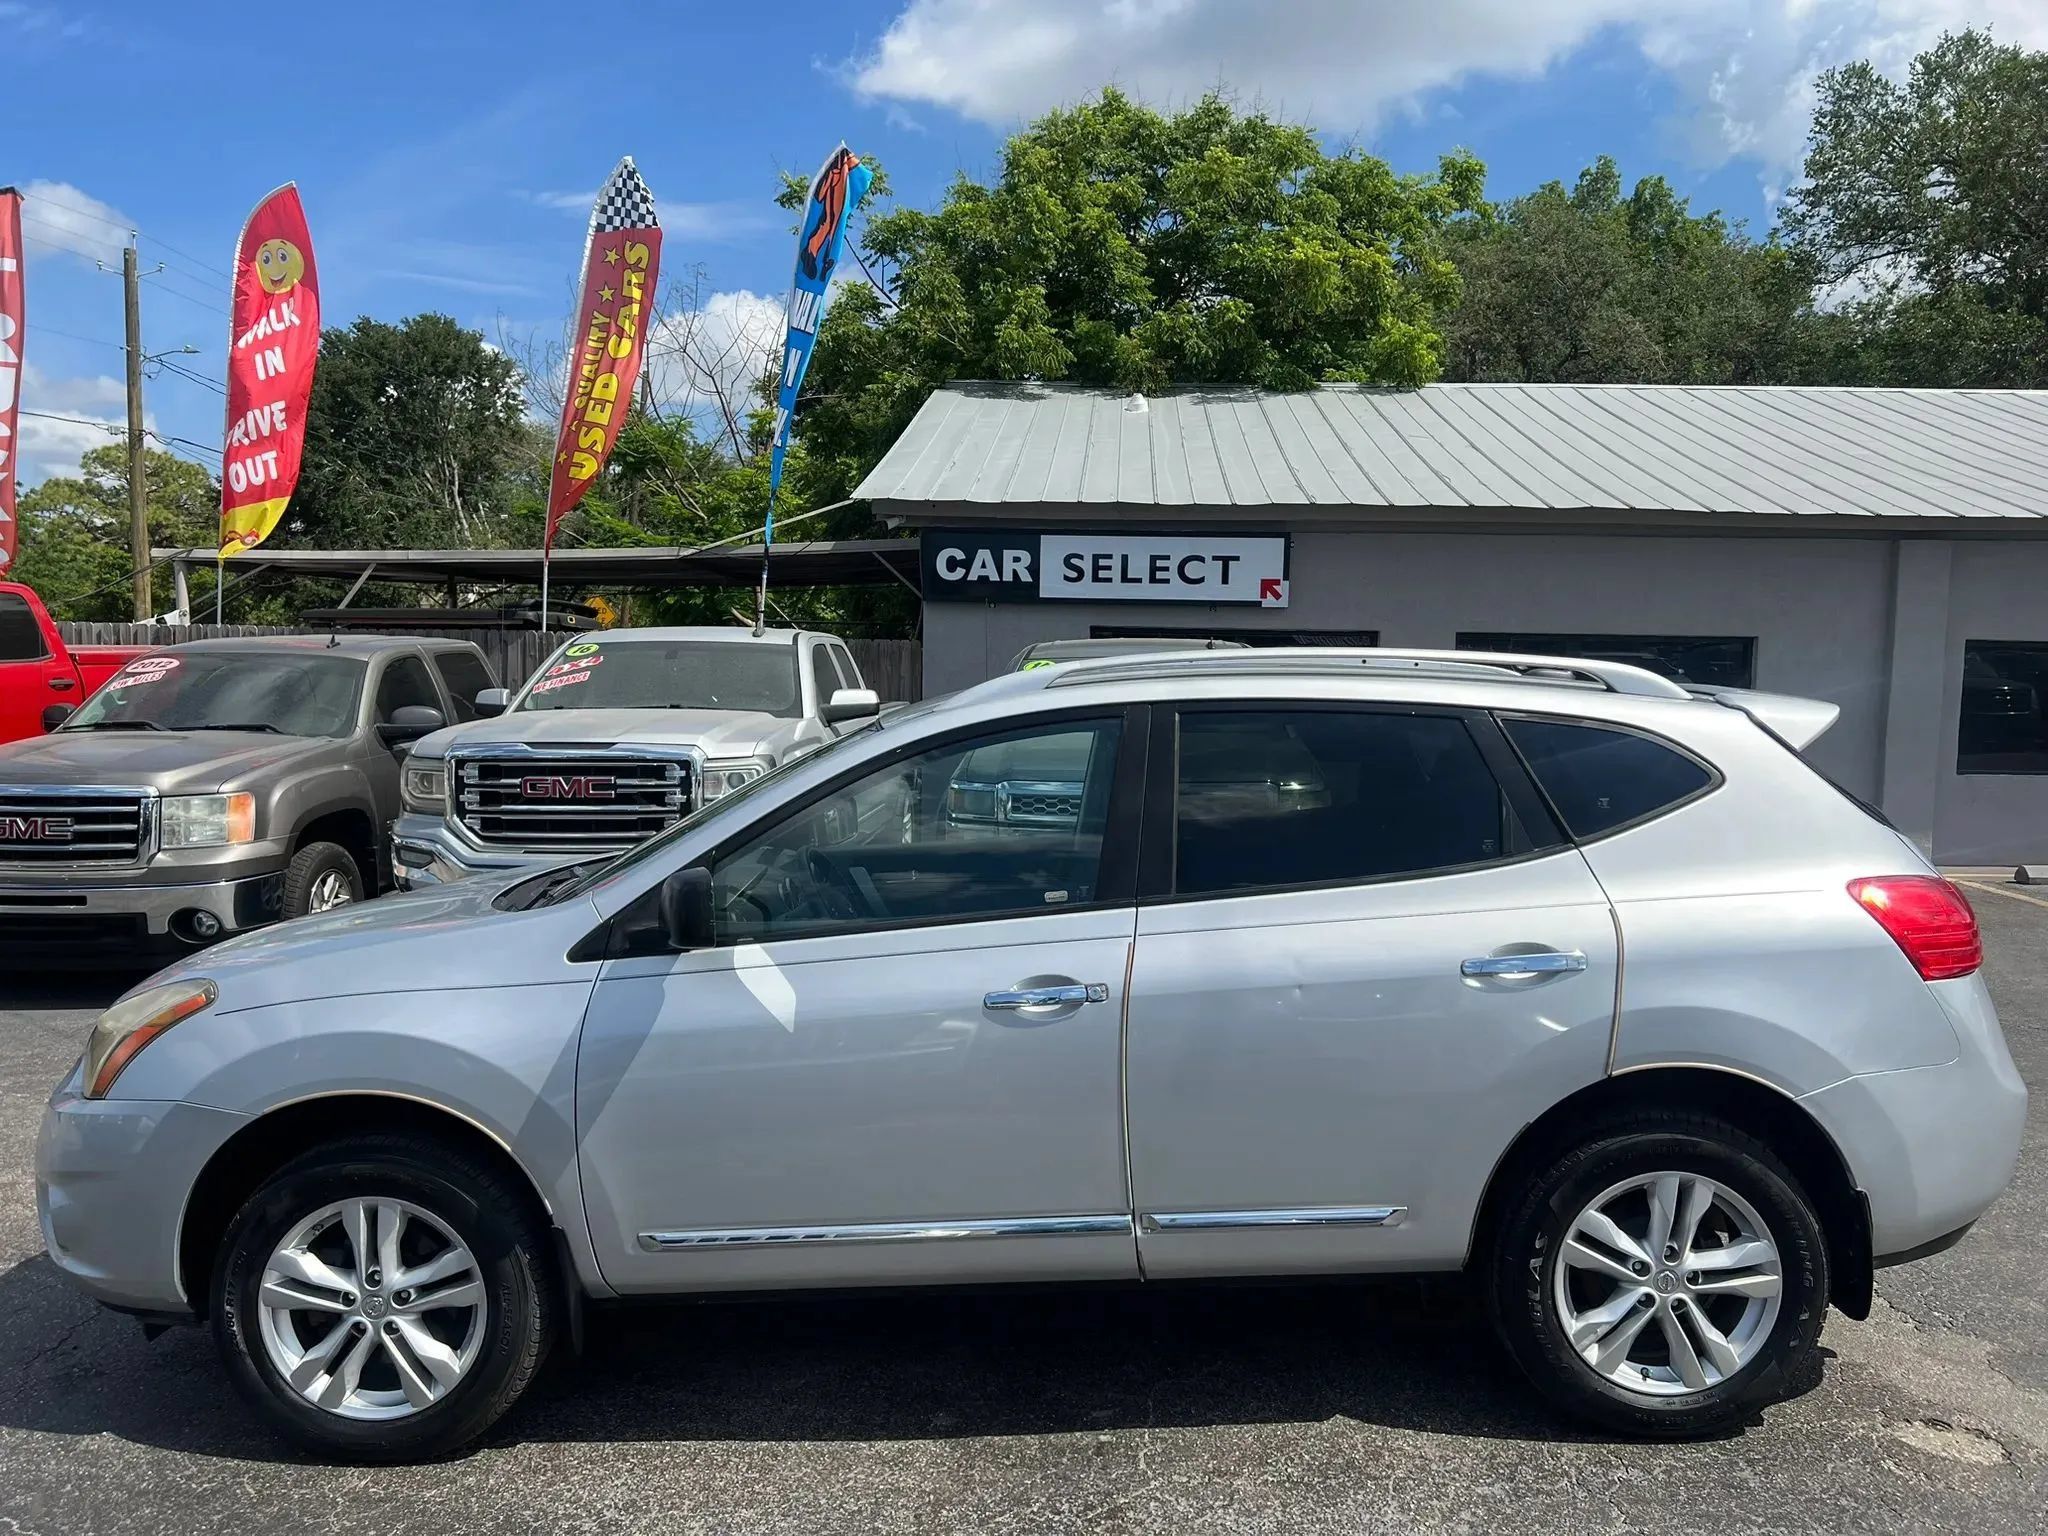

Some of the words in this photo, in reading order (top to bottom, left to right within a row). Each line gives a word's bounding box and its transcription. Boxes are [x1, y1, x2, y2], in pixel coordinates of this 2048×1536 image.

[237, 297, 301, 349] WALK
[254, 345, 287, 381] IN
[568, 372, 619, 480] USED
[607, 240, 650, 359] CARS
[574, 310, 611, 409] QUALITY
[224, 400, 288, 448] RIVE
[228, 450, 279, 493] OUT
[936, 547, 1034, 583] CAR
[1062, 552, 1241, 586] SELECT
[130, 660, 174, 671] 2012
[571, 645, 594, 655] 16
[131, 670, 166, 685] MILES
[533, 681, 548, 693] WE
[547, 672, 589, 687] FINANCE
[522, 776, 616, 798] GMC
[0, 817, 74, 840] MC
